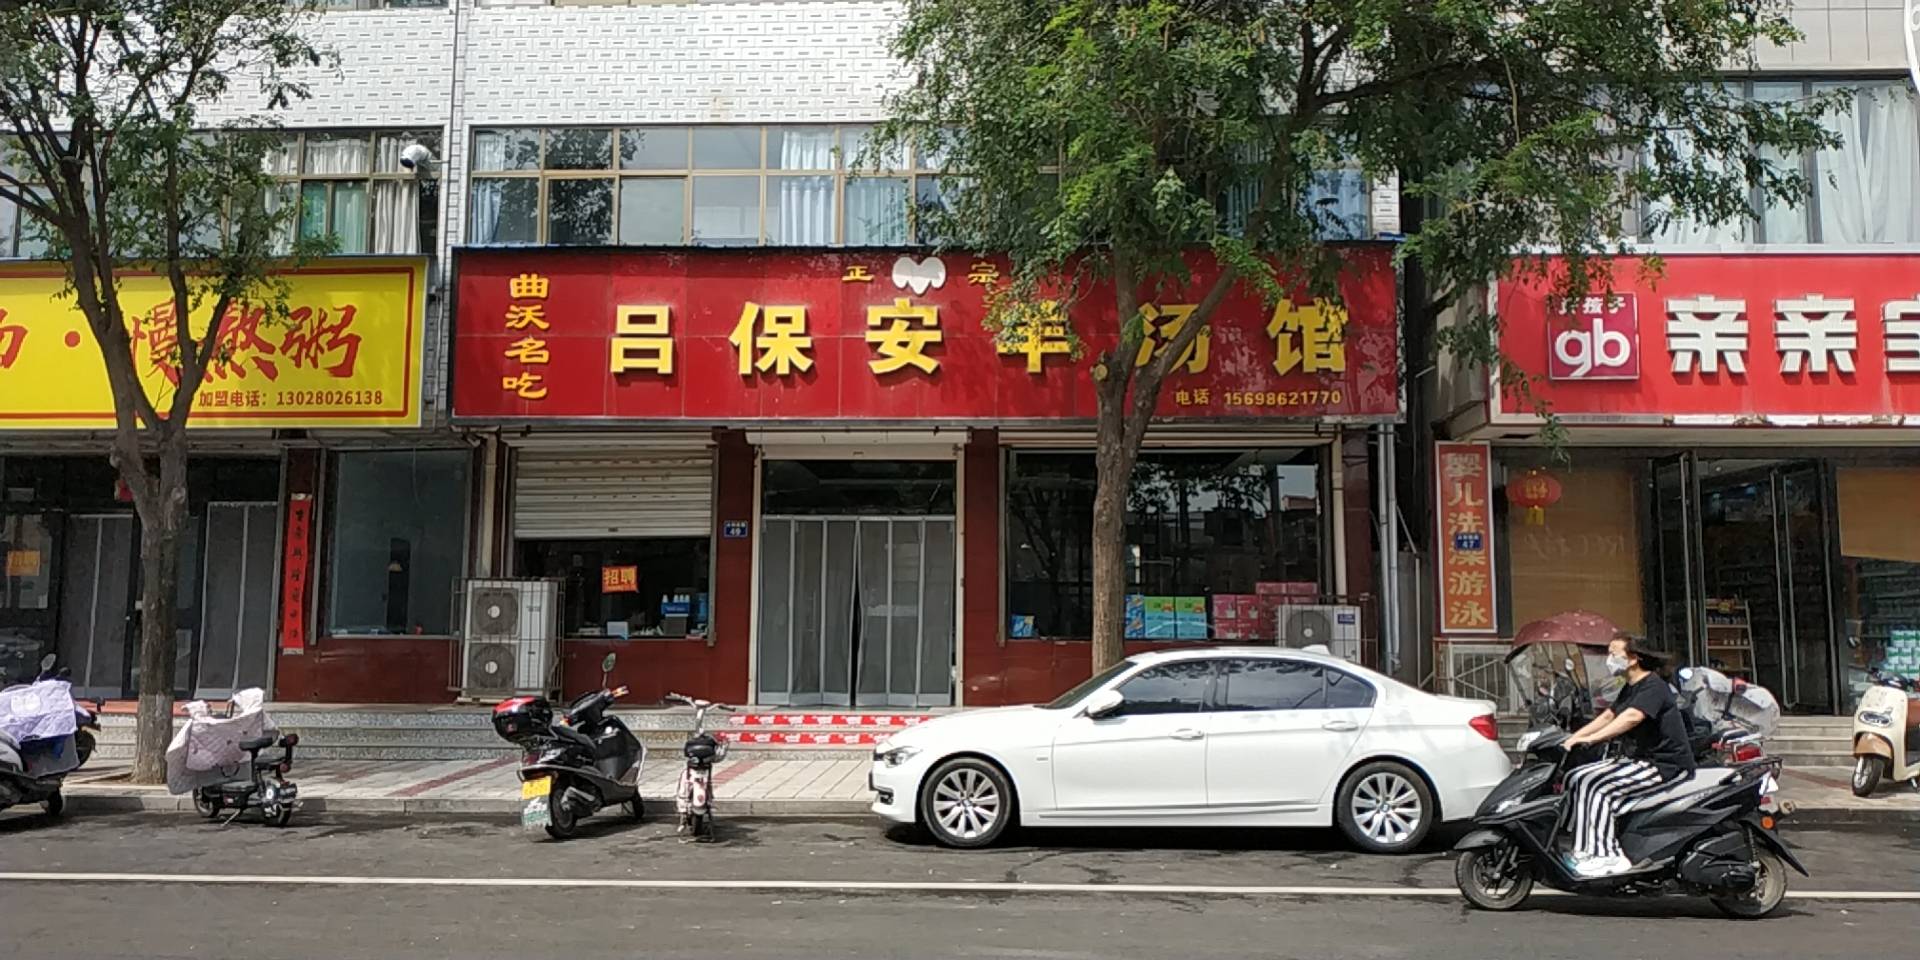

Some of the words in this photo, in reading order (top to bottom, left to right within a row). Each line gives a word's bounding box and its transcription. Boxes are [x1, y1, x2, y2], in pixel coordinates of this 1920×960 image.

[502, 274, 550, 398] 曲沃名吃
[610, 298, 1348, 376] 吕保安羊汤馆
[1555, 318, 1630, 378] gb
[1176, 389, 1209, 405] 电话
[1225, 391, 1341, 406] 15698621770
